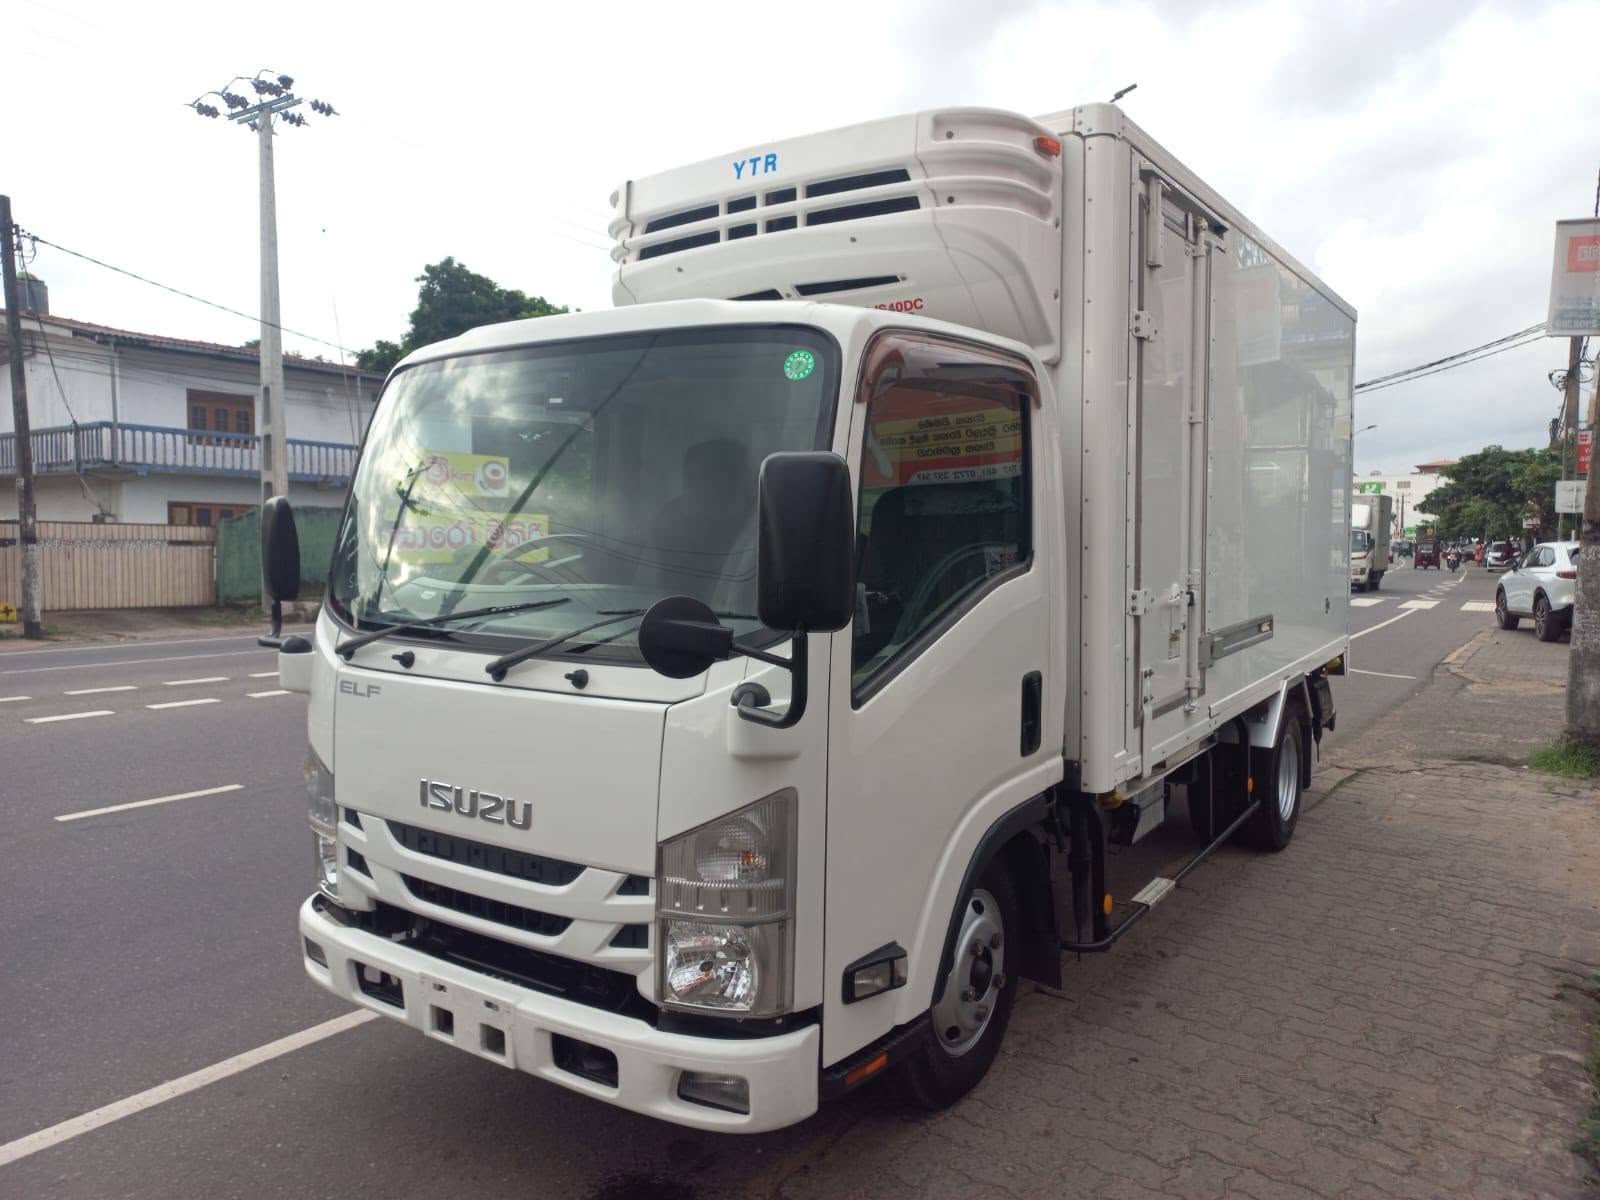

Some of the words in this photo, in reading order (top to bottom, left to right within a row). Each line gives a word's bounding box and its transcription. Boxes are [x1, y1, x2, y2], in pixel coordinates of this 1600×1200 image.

[733, 153, 777, 180] YTR
[340, 680, 382, 697] ELF
[421, 779, 533, 830] ISUZU
